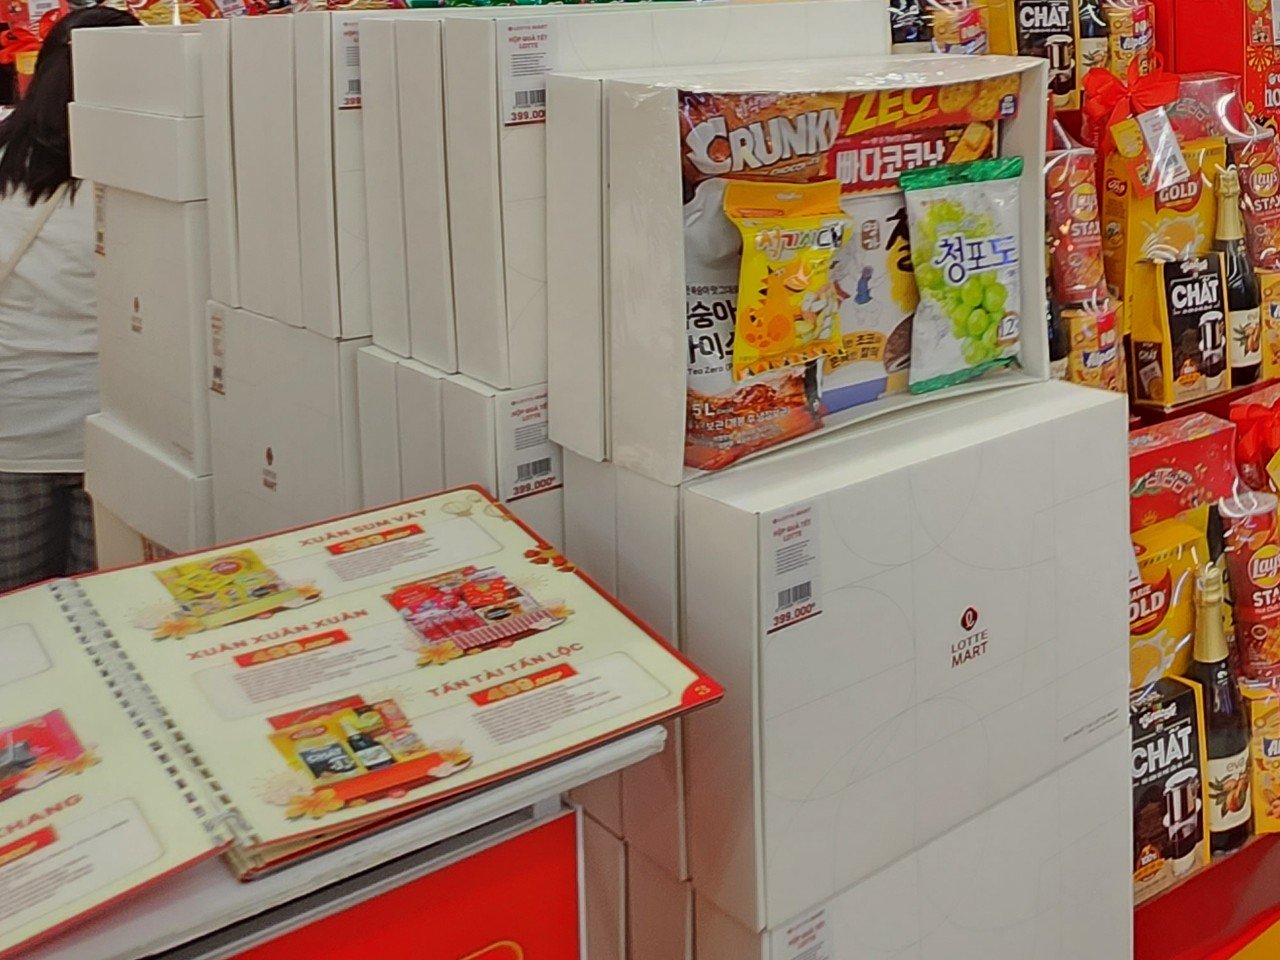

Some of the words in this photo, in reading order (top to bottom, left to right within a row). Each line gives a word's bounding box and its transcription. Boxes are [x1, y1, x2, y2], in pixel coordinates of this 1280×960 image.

[1019, 1, 1070, 28] CHẤT
[1159, 181, 1198, 202] GOLD
[933, 235, 1018, 287] 청포도
[1171, 275, 1220, 310] CHẤT
[705, 366, 724, 374] Zero
[352, 519, 391, 533] SUM
[188, 640, 248, 660] XUÂN
[251, 624, 310, 644] XUÂN
[314, 609, 368, 628] XUÂN
[949, 628, 989, 654] LOTTE
[950, 641, 989, 669] MART
[426, 681, 470, 697] TẤN
[470, 669, 505, 683] TÀI
[504, 655, 545, 672] TẤN
[547, 642, 584, 659] LỘC
[1132, 725, 1193, 781] CHẤT
[1226, 756, 1250, 772] eva
